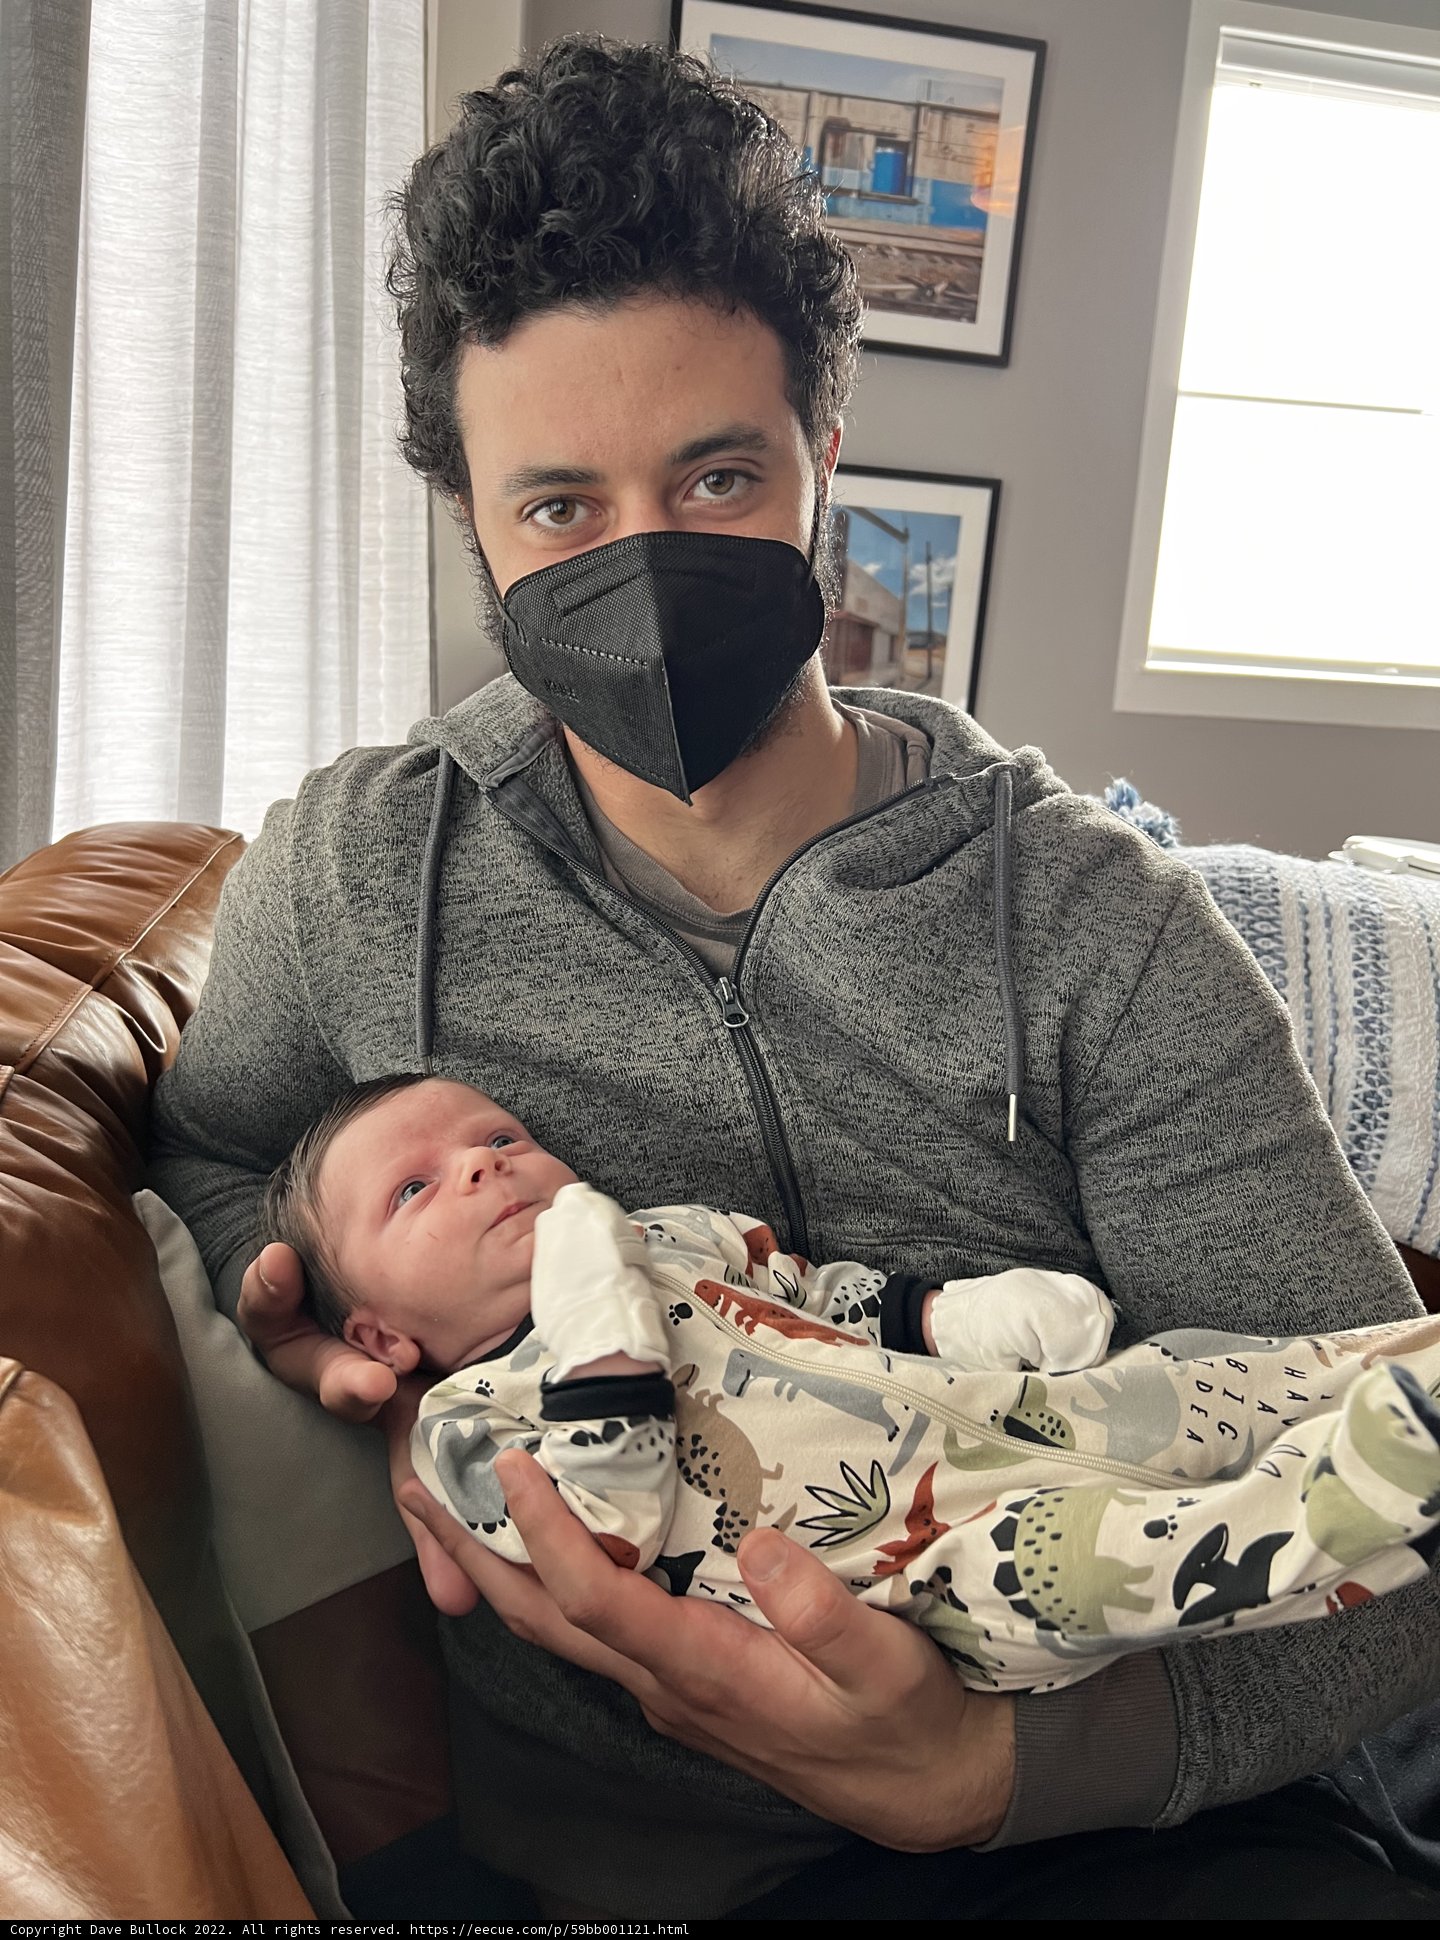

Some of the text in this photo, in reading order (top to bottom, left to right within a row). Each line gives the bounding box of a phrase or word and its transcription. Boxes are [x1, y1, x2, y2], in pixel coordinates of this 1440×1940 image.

[1186, 1359, 1215, 1444] IDEA
[1217, 1357, 1249, 1440] BIG
[1257, 1400, 1278, 1415] A
[1276, 1366, 1309, 1434] HAV
